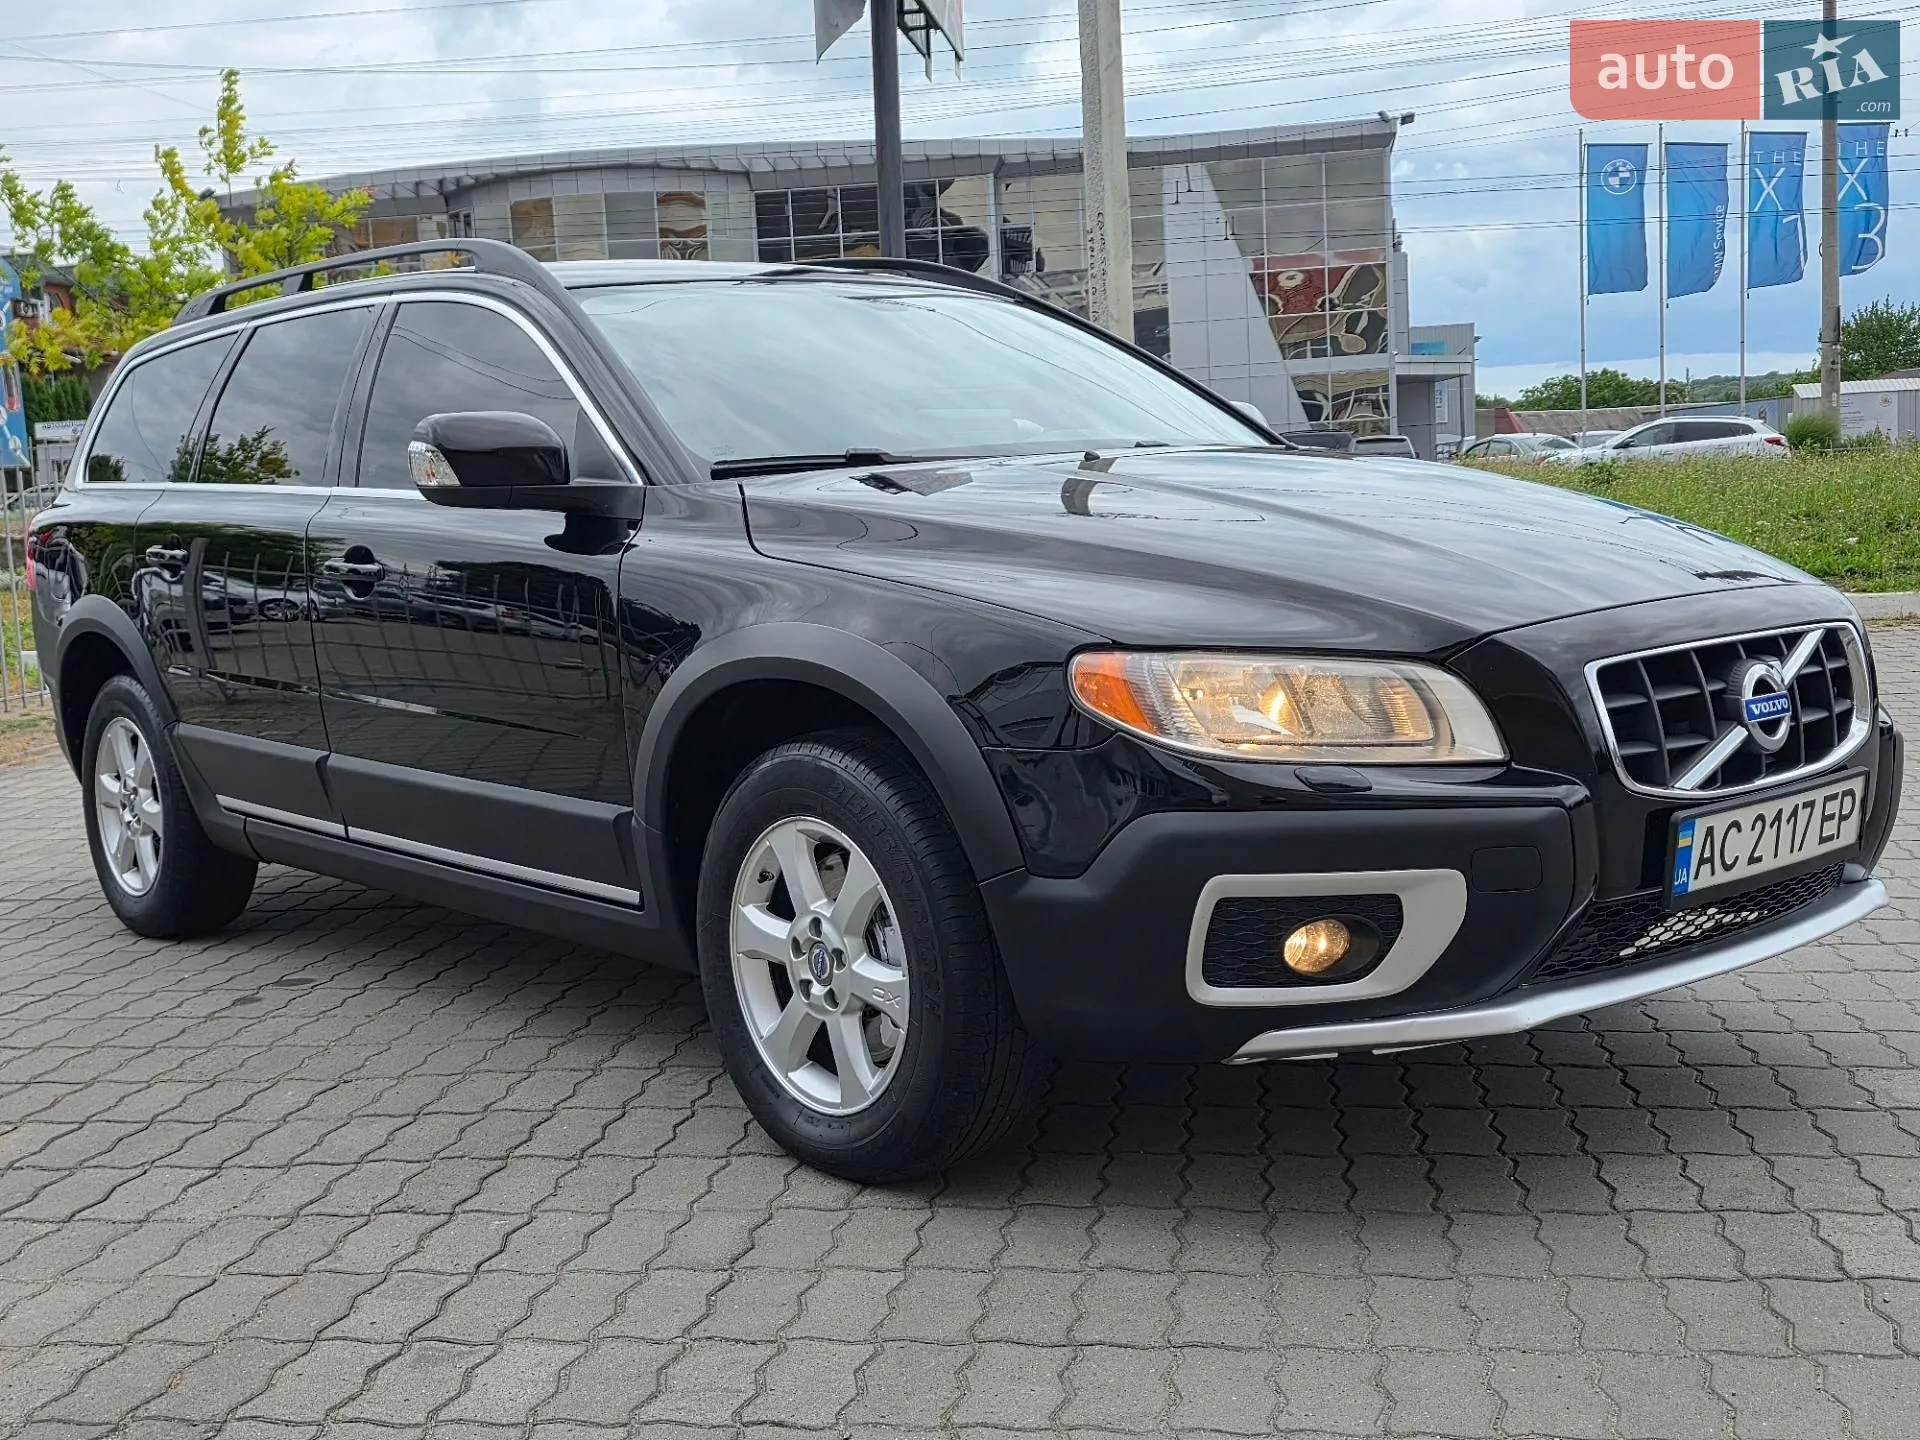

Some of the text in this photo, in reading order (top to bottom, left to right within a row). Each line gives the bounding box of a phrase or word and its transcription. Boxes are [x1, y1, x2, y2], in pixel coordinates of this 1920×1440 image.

[1753, 151, 1802, 166] THE
[1750, 697, 1789, 715] VOLVO
[1693, 787, 1858, 881] AC 2117 EP
[1674, 867, 1688, 886] UA
